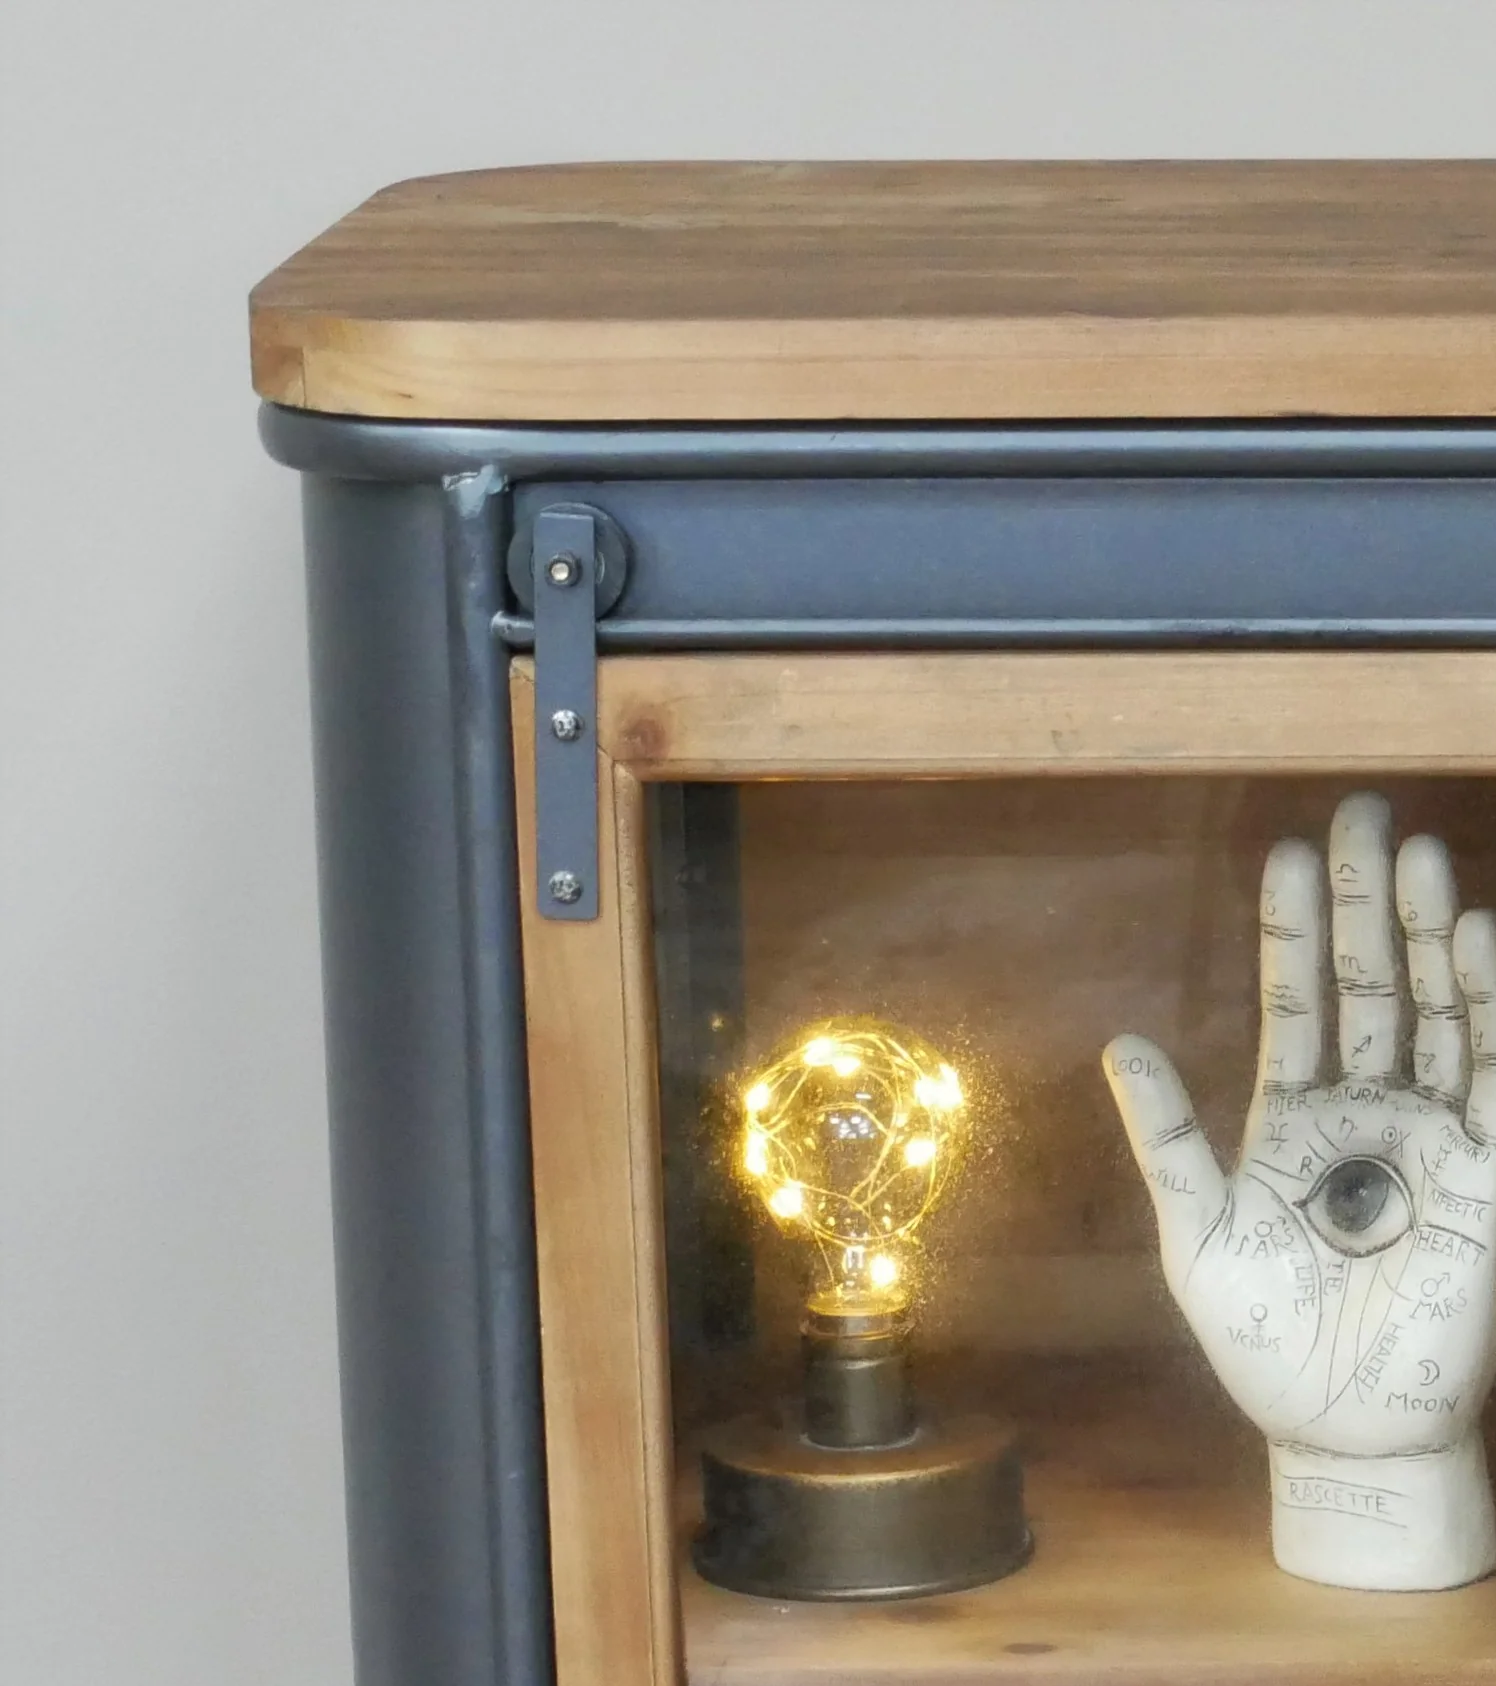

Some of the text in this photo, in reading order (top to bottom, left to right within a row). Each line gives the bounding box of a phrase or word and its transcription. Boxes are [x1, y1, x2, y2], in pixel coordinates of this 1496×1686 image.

[1416, 1230, 1485, 1266] HEART
[1409, 1288, 1468, 1320] MARS
[1358, 1322, 1404, 1393] HEALTH
